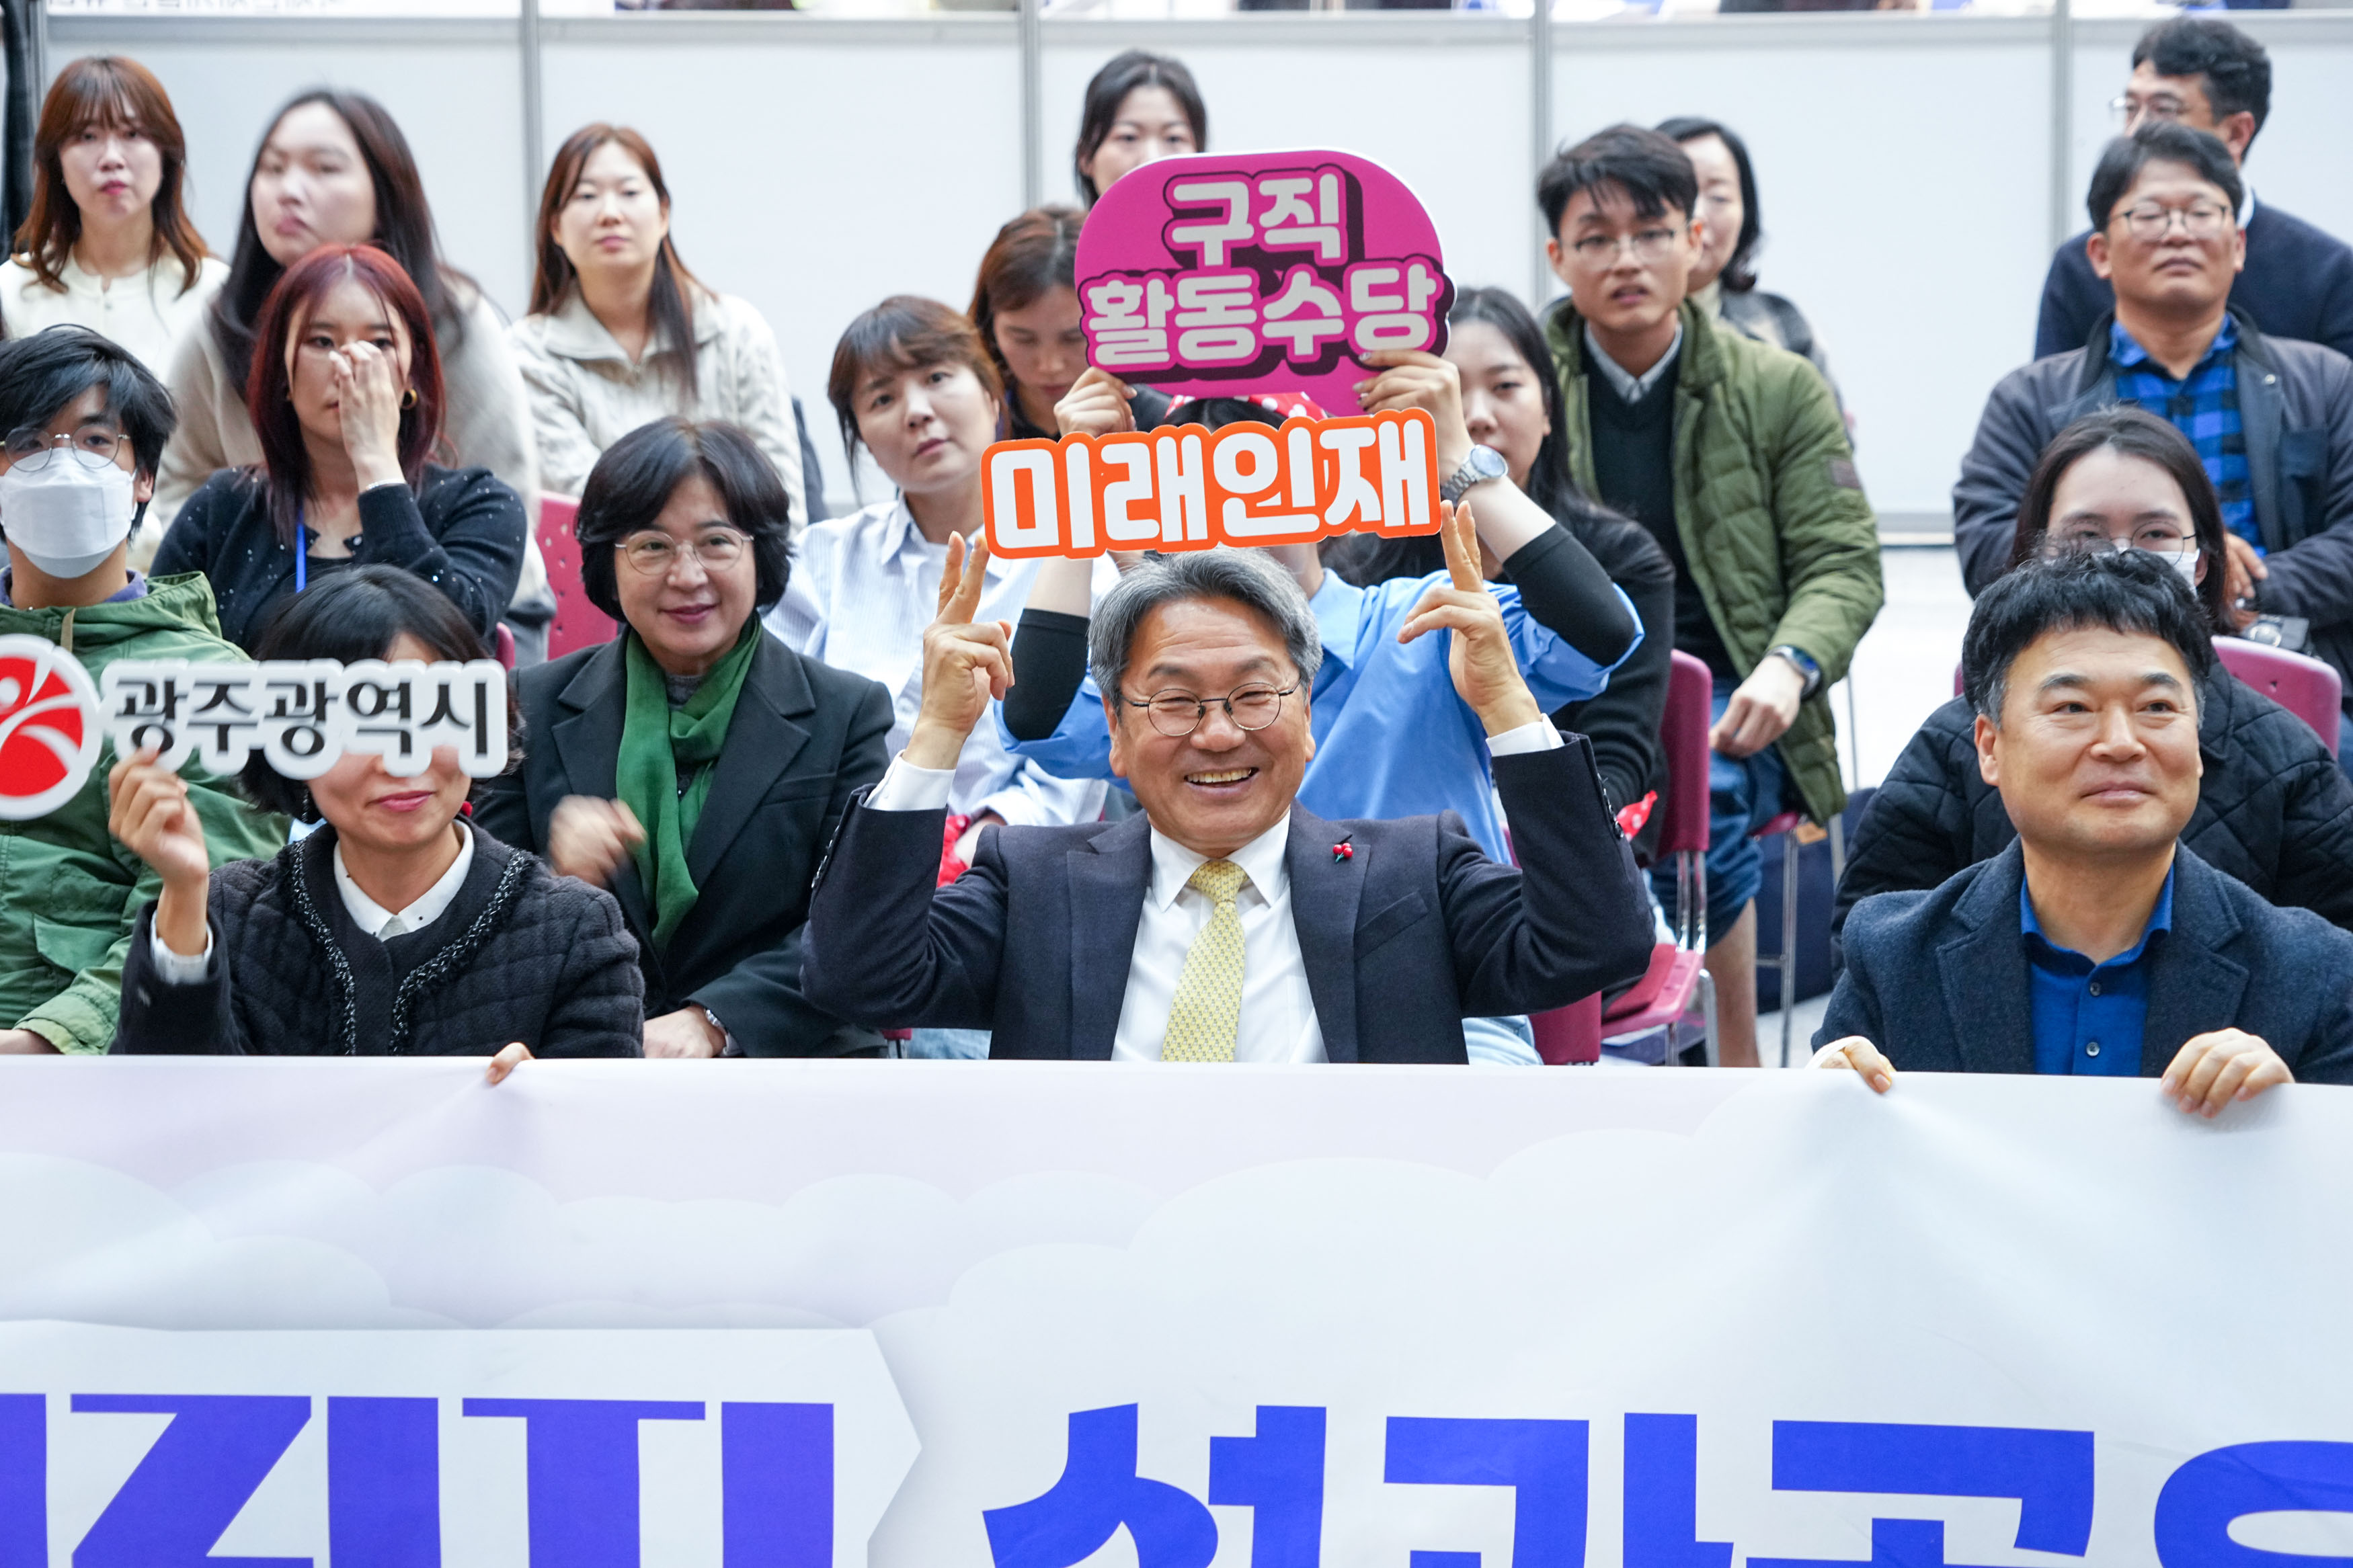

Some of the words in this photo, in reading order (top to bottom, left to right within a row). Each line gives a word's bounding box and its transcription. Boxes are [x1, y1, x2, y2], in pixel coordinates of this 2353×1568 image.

[1172, 173, 1342, 265] 구직
[1086, 263, 1437, 366] 활동수당
[990, 418, 1430, 549] 미래인재
[115, 677, 488, 755] 광주광역시
